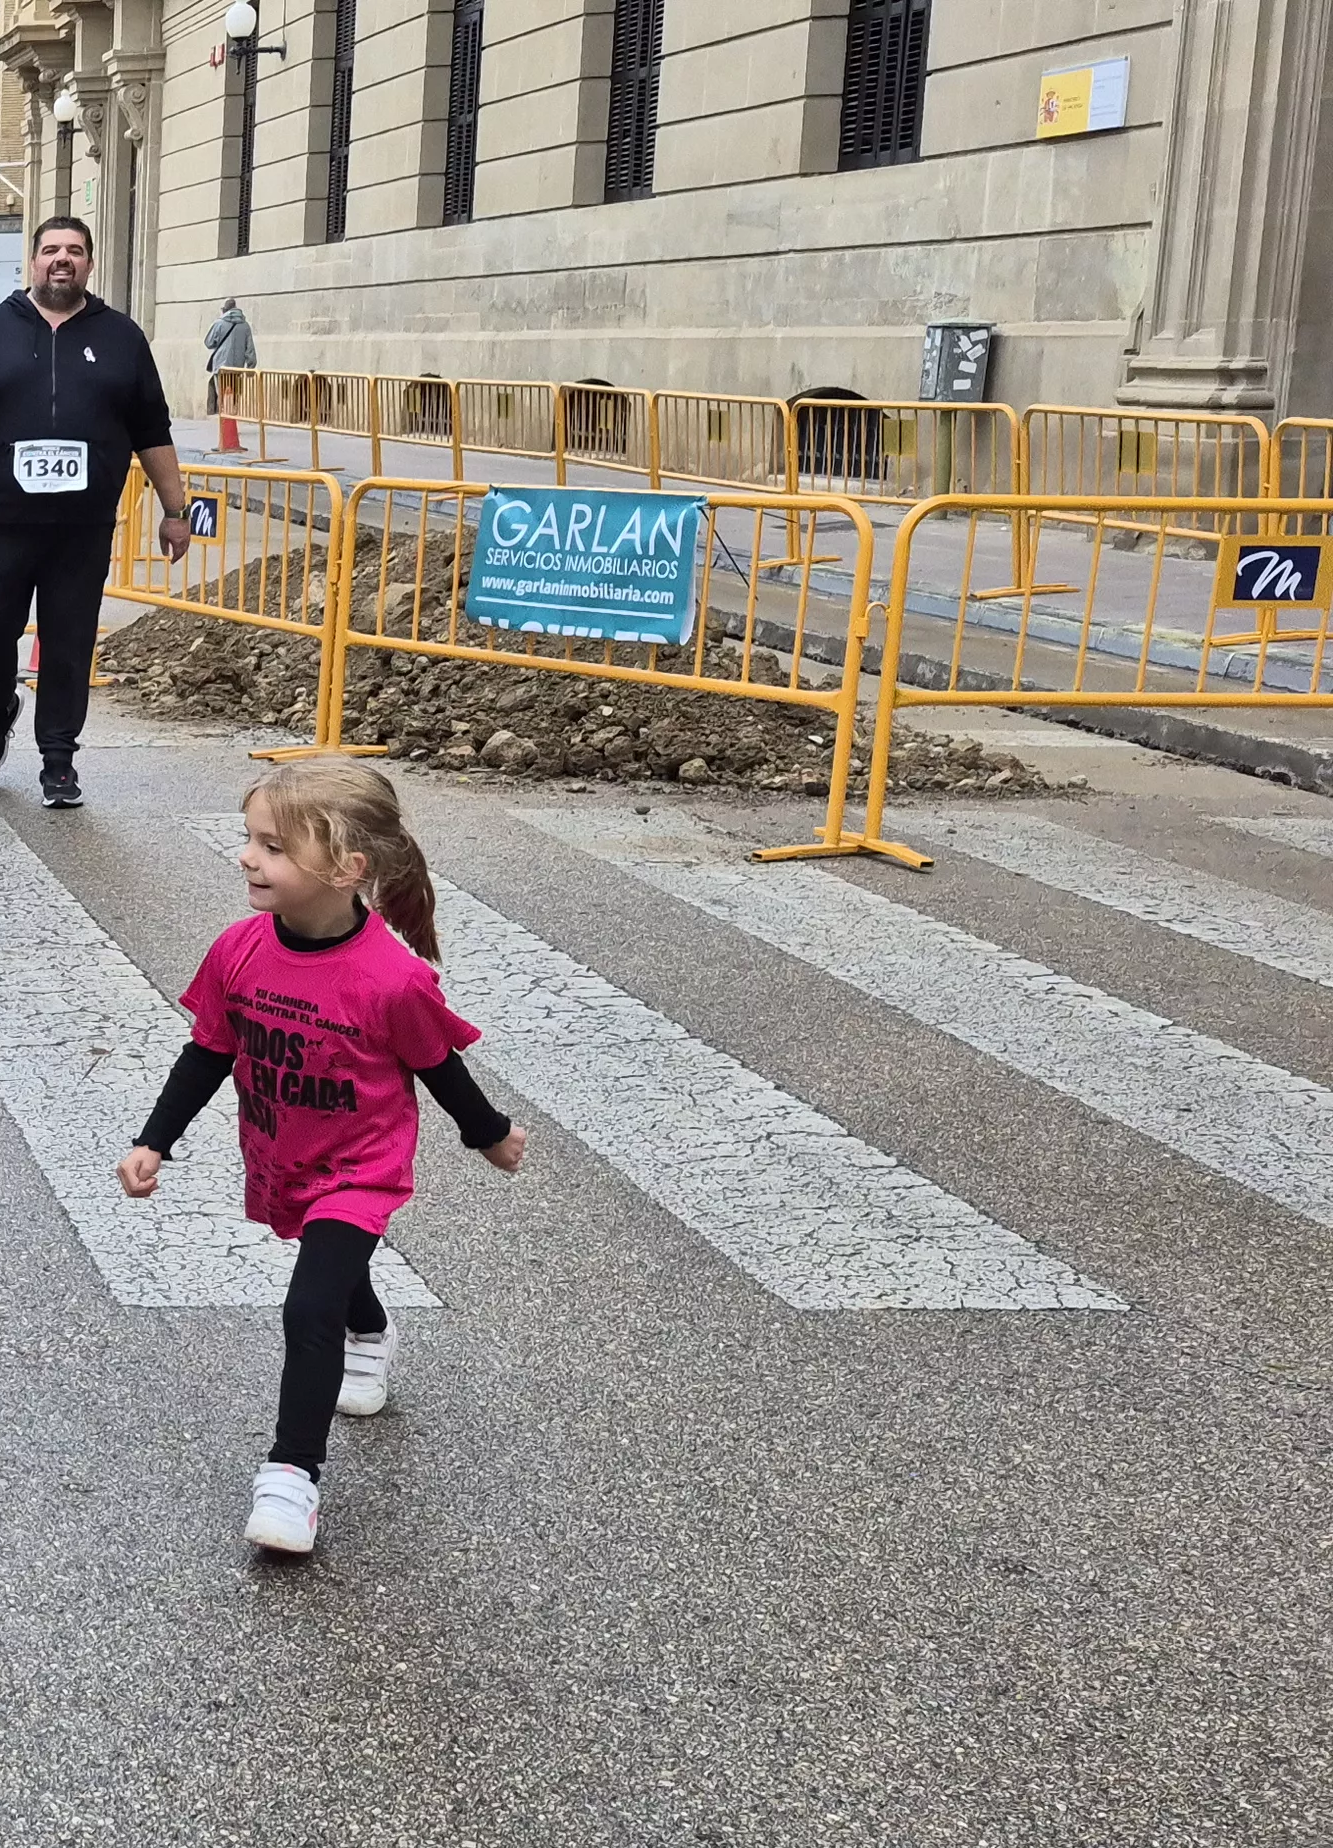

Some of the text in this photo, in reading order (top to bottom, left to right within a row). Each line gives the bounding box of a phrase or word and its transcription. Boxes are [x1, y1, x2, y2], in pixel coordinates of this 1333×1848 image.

[22, 458, 79, 478] 1340
[492, 500, 687, 558] GARLAN
[485, 547, 679, 580] SERVICIOS INMOBILIARIOS
[482, 576, 675, 605] www.garlaninmobiliaria.com
[255, 1000, 297, 1021] CONTRA
[299, 1013, 312, 1025] EL
[314, 1018, 362, 1038] CÁNCER
[269, 993, 319, 1014] CARRERA
[280, 1072, 358, 1113] CADA
